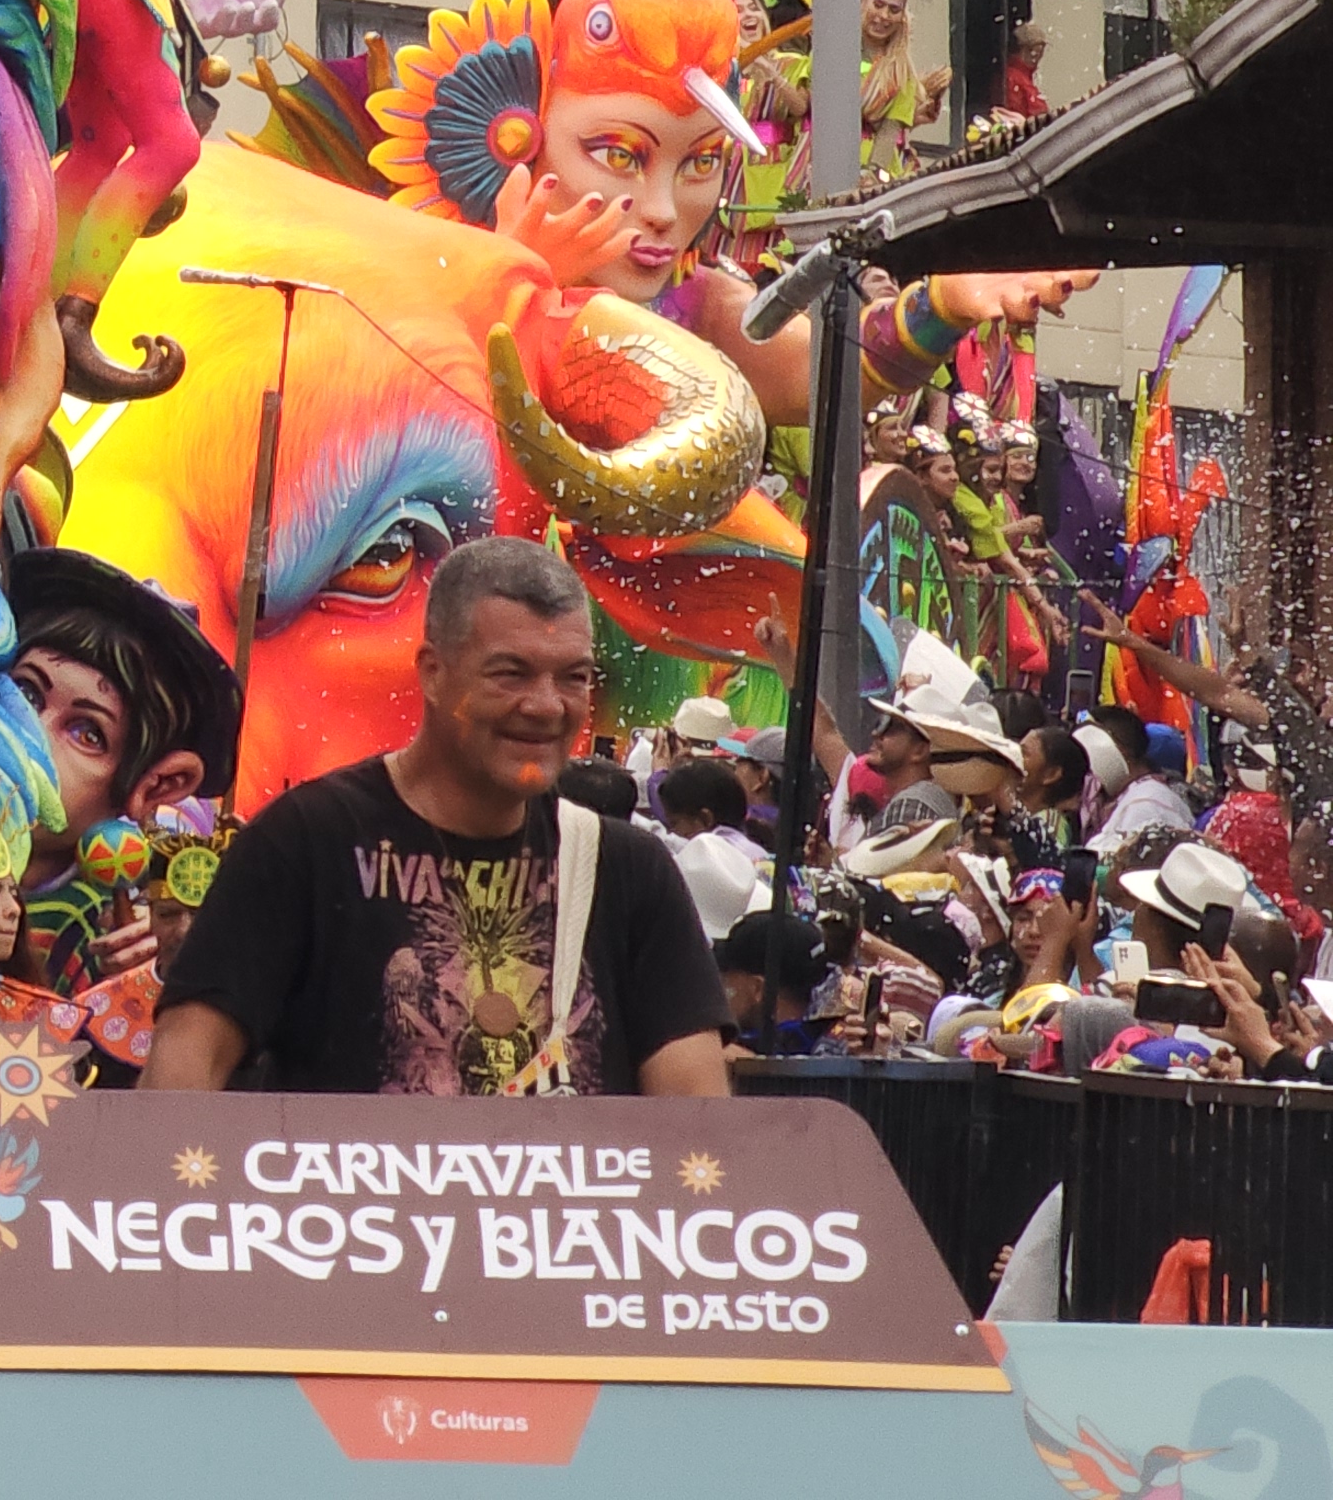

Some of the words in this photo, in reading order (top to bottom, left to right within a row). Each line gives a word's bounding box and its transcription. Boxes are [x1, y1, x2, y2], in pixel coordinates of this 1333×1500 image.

[353, 838, 444, 905] VIVA
[243, 1139, 641, 1198] CARNAVAL
[595, 1147, 653, 1179] DE
[42, 1199, 404, 1281] NEGROS
[478, 1206, 869, 1283] BLANCOS
[583, 1292, 647, 1329] DE
[430, 1409, 530, 1432] Culturas
